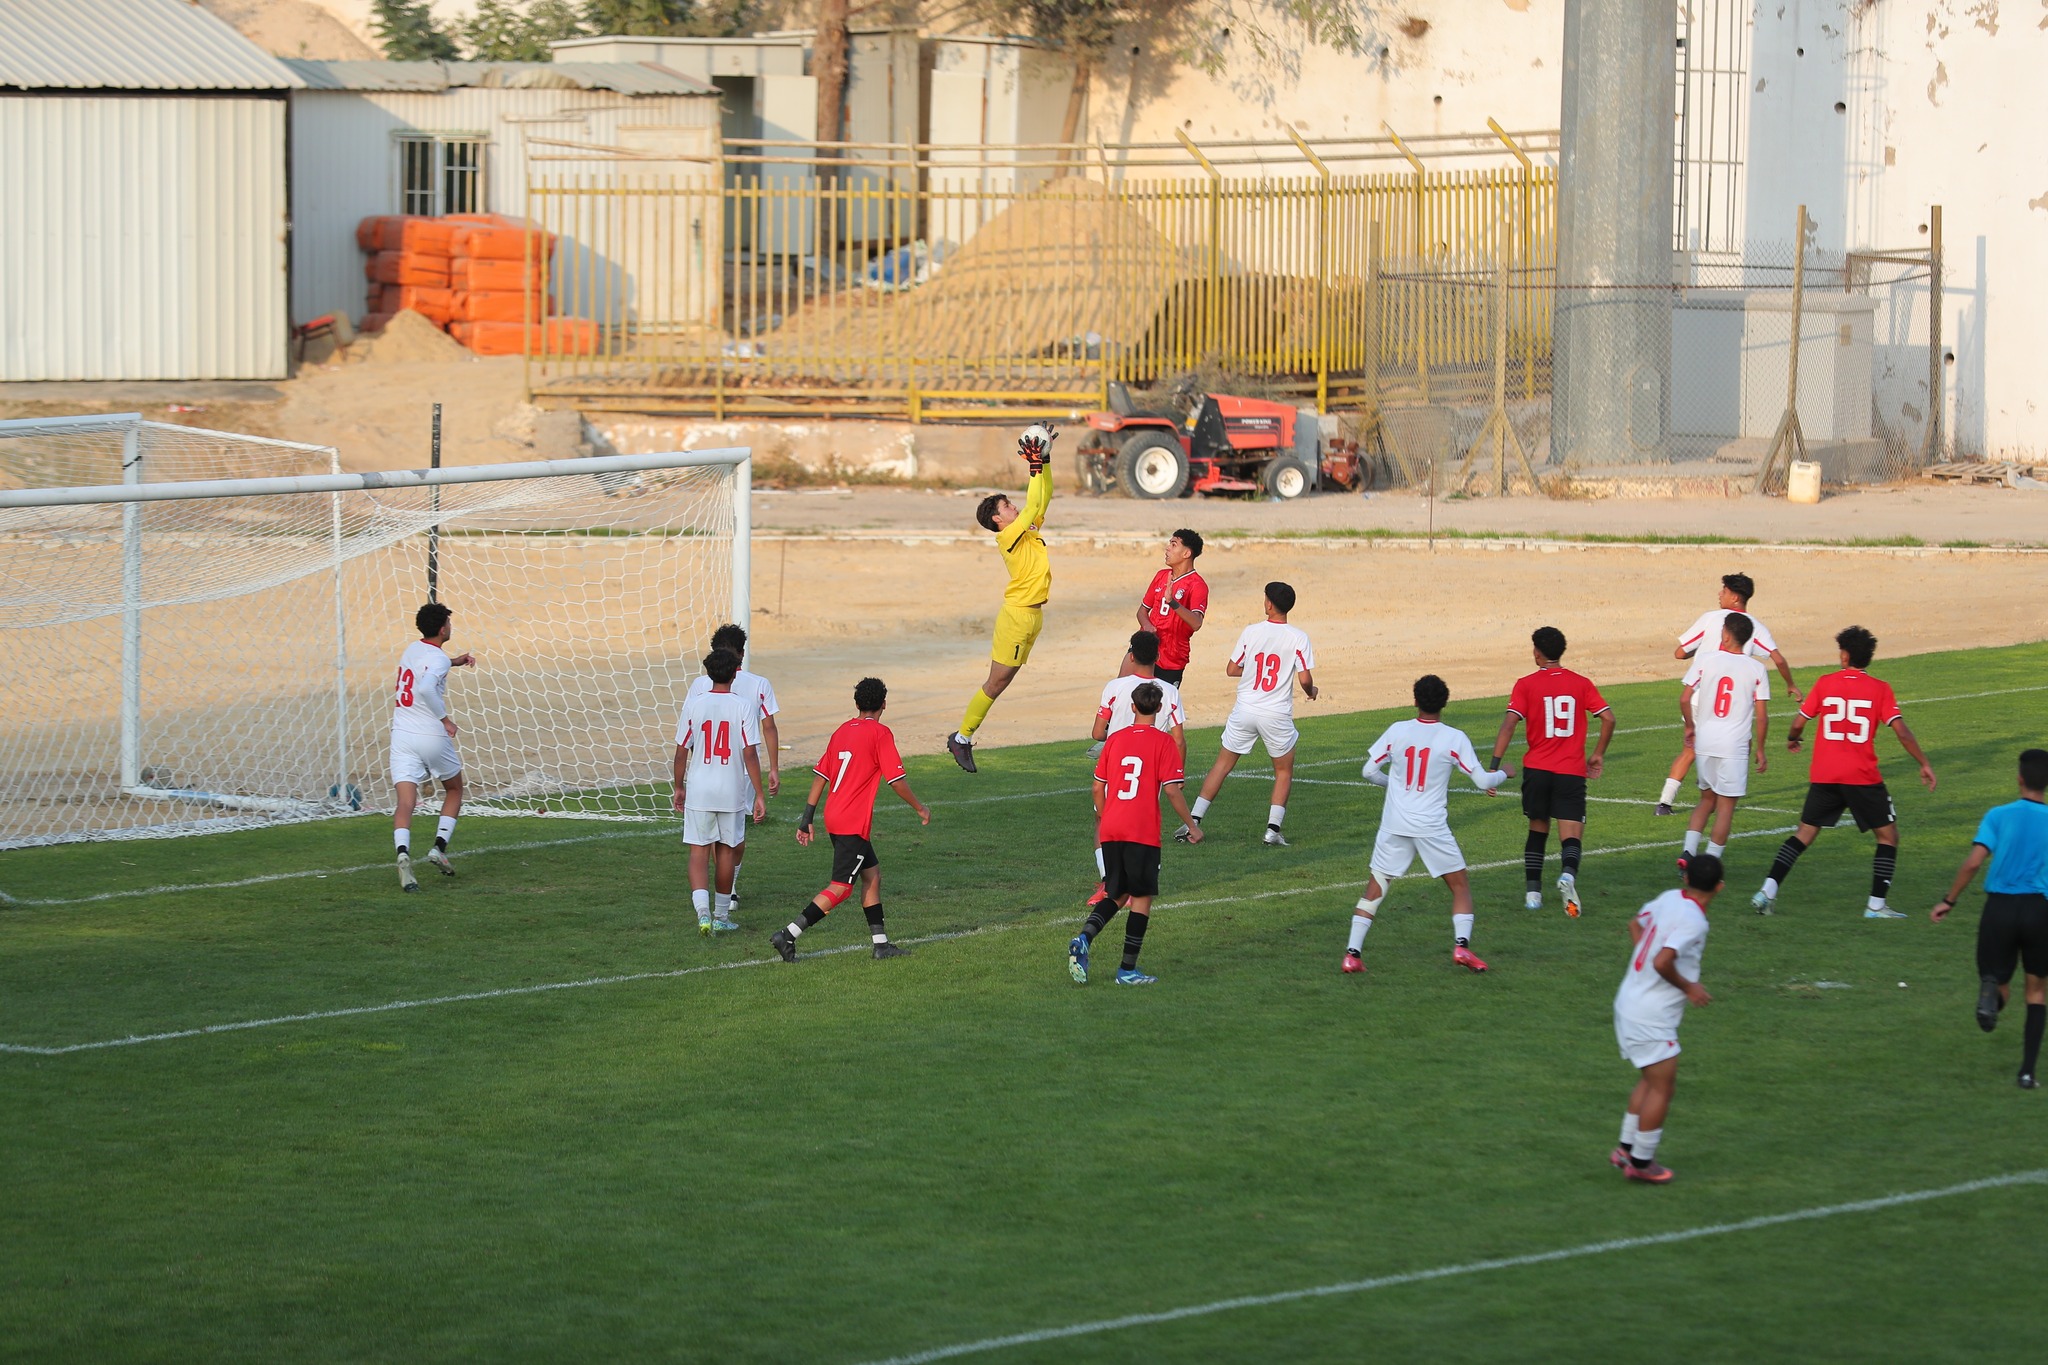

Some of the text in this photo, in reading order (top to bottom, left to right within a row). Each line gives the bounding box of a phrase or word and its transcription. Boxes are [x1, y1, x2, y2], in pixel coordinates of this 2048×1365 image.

[1160, 596, 1170, 616] 6
[1014, 644, 1020, 660] 1
[1253, 651, 1281, 692] 13
[1543, 695, 1576, 739] 19
[1714, 675, 1734, 719] 6
[701, 719, 731, 765] 14
[1822, 696, 1873, 744] 25
[832, 750, 853, 793] 7
[1117, 755, 1143, 801] 3
[1404, 745, 1431, 792] 11
[856, 854, 865, 876] 7
